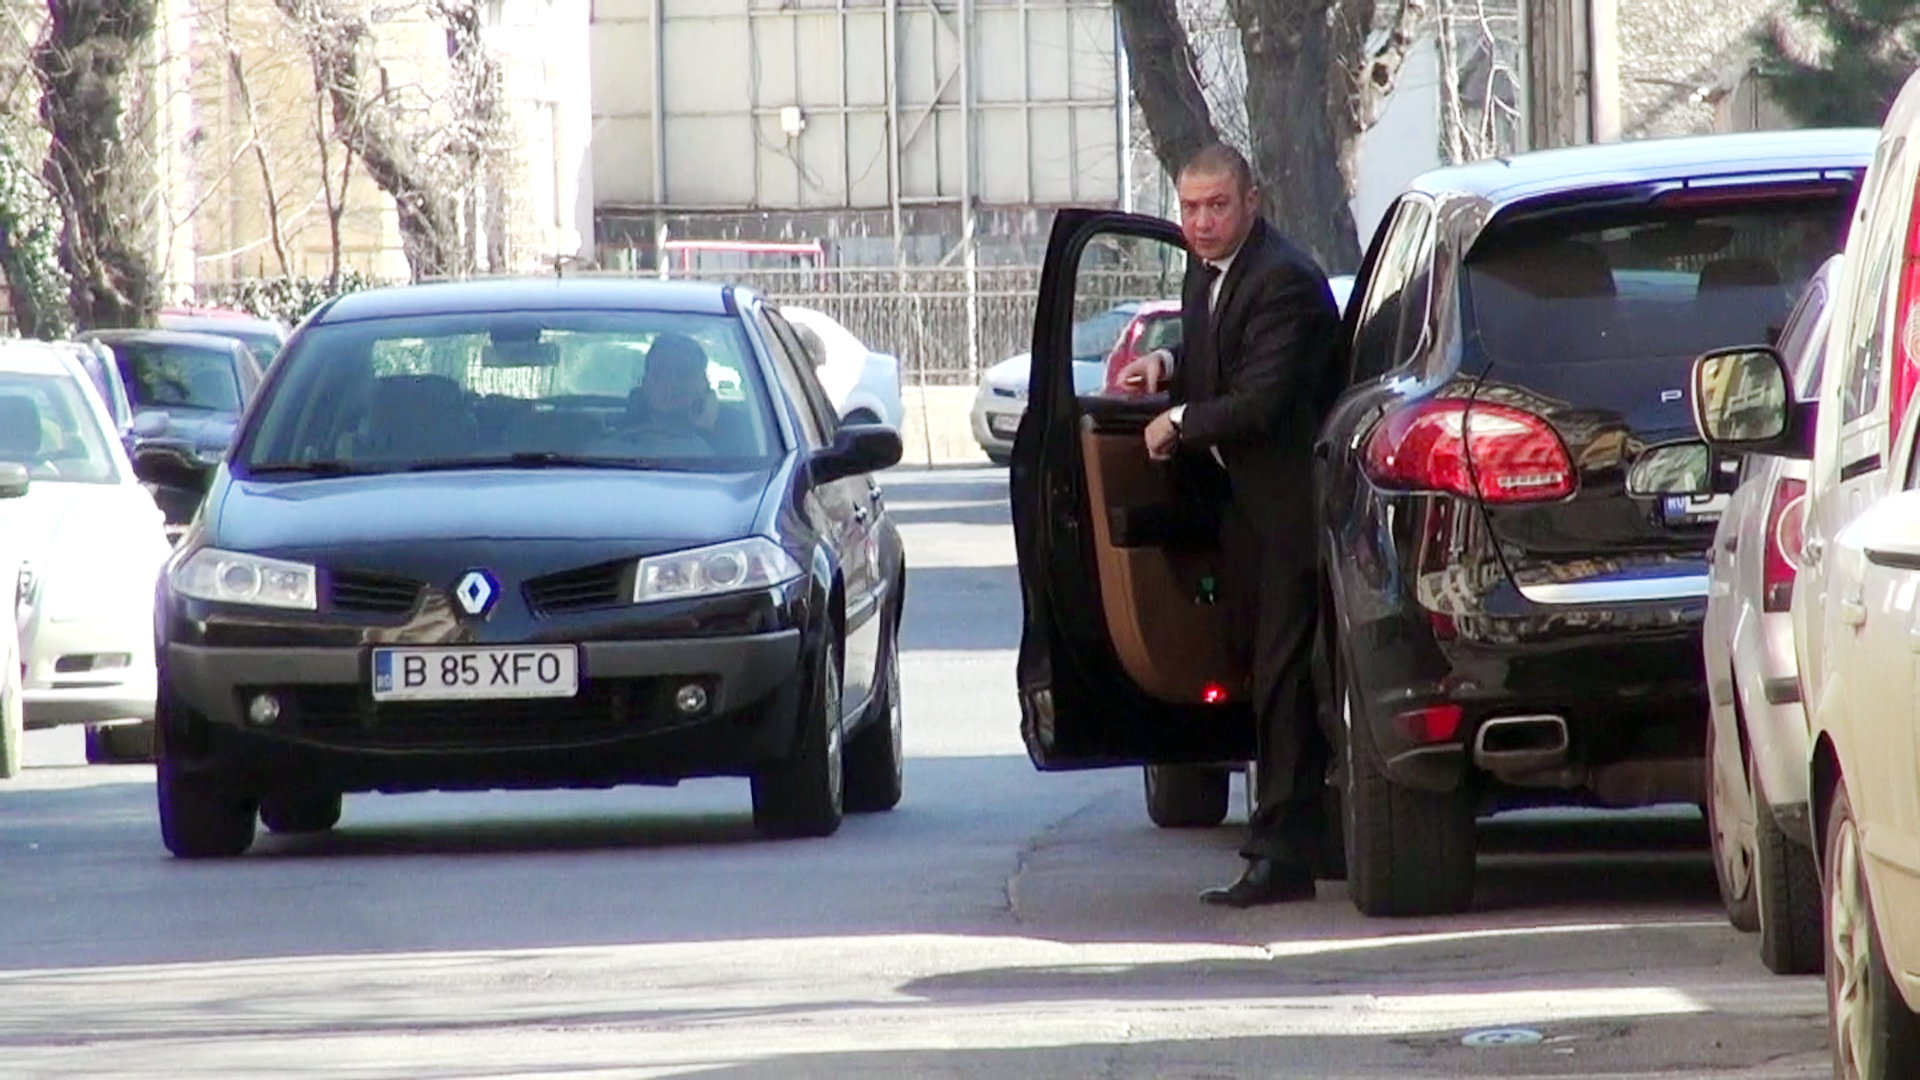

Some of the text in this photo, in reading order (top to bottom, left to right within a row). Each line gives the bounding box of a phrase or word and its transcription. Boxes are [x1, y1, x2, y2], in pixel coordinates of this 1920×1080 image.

[404, 652, 561, 688] B 85 XFO
